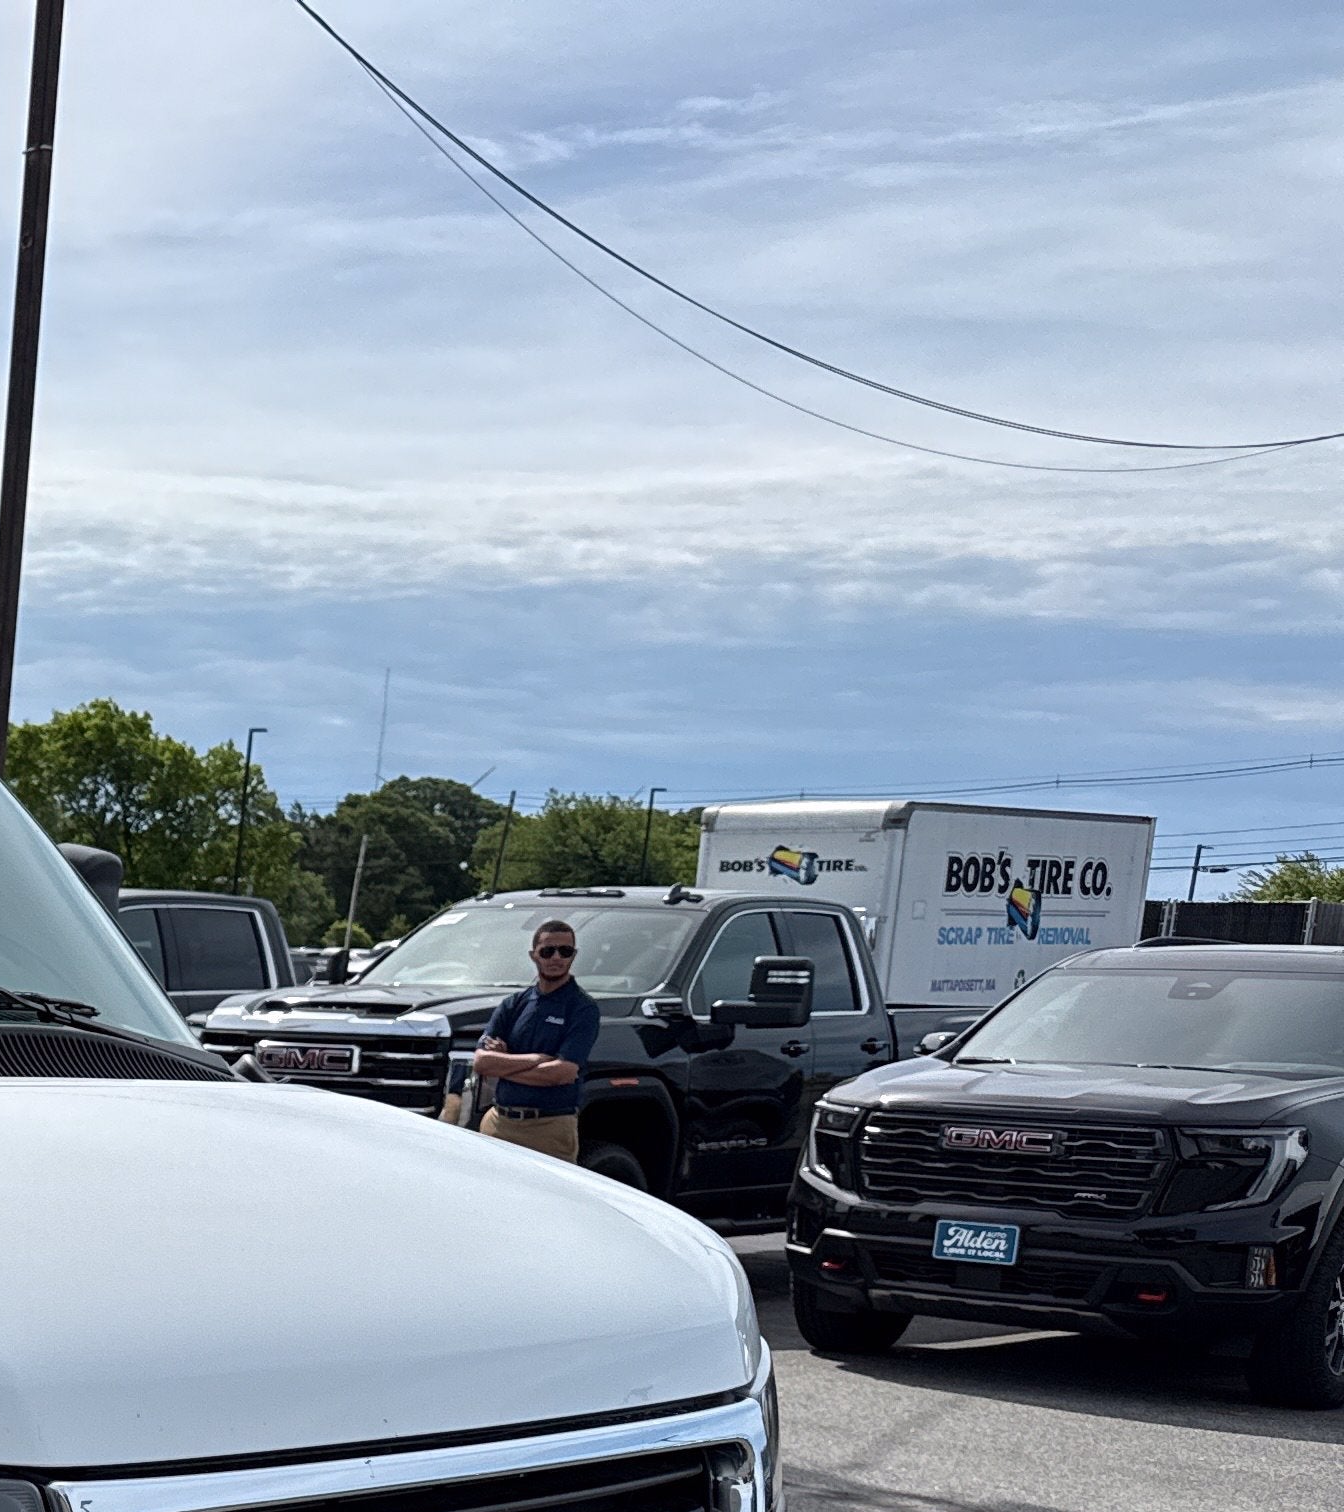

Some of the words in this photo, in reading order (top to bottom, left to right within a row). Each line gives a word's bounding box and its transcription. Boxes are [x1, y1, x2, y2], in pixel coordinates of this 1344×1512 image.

[719, 857, 766, 872] BOB'S
[816, 858, 855, 872] TIRE
[943, 849, 1012, 895] BOB'S
[1026, 858, 1075, 895] TIRE
[1079, 860, 1112, 897] CO.
[937, 926, 983, 945] SCRAP
[987, 927, 1014, 945] TIRE
[1037, 927, 1091, 945] REMOVAL
[259, 1047, 351, 1070] GMC
[946, 1126, 1054, 1152] GMC
[943, 1226, 1008, 1251] Alden
